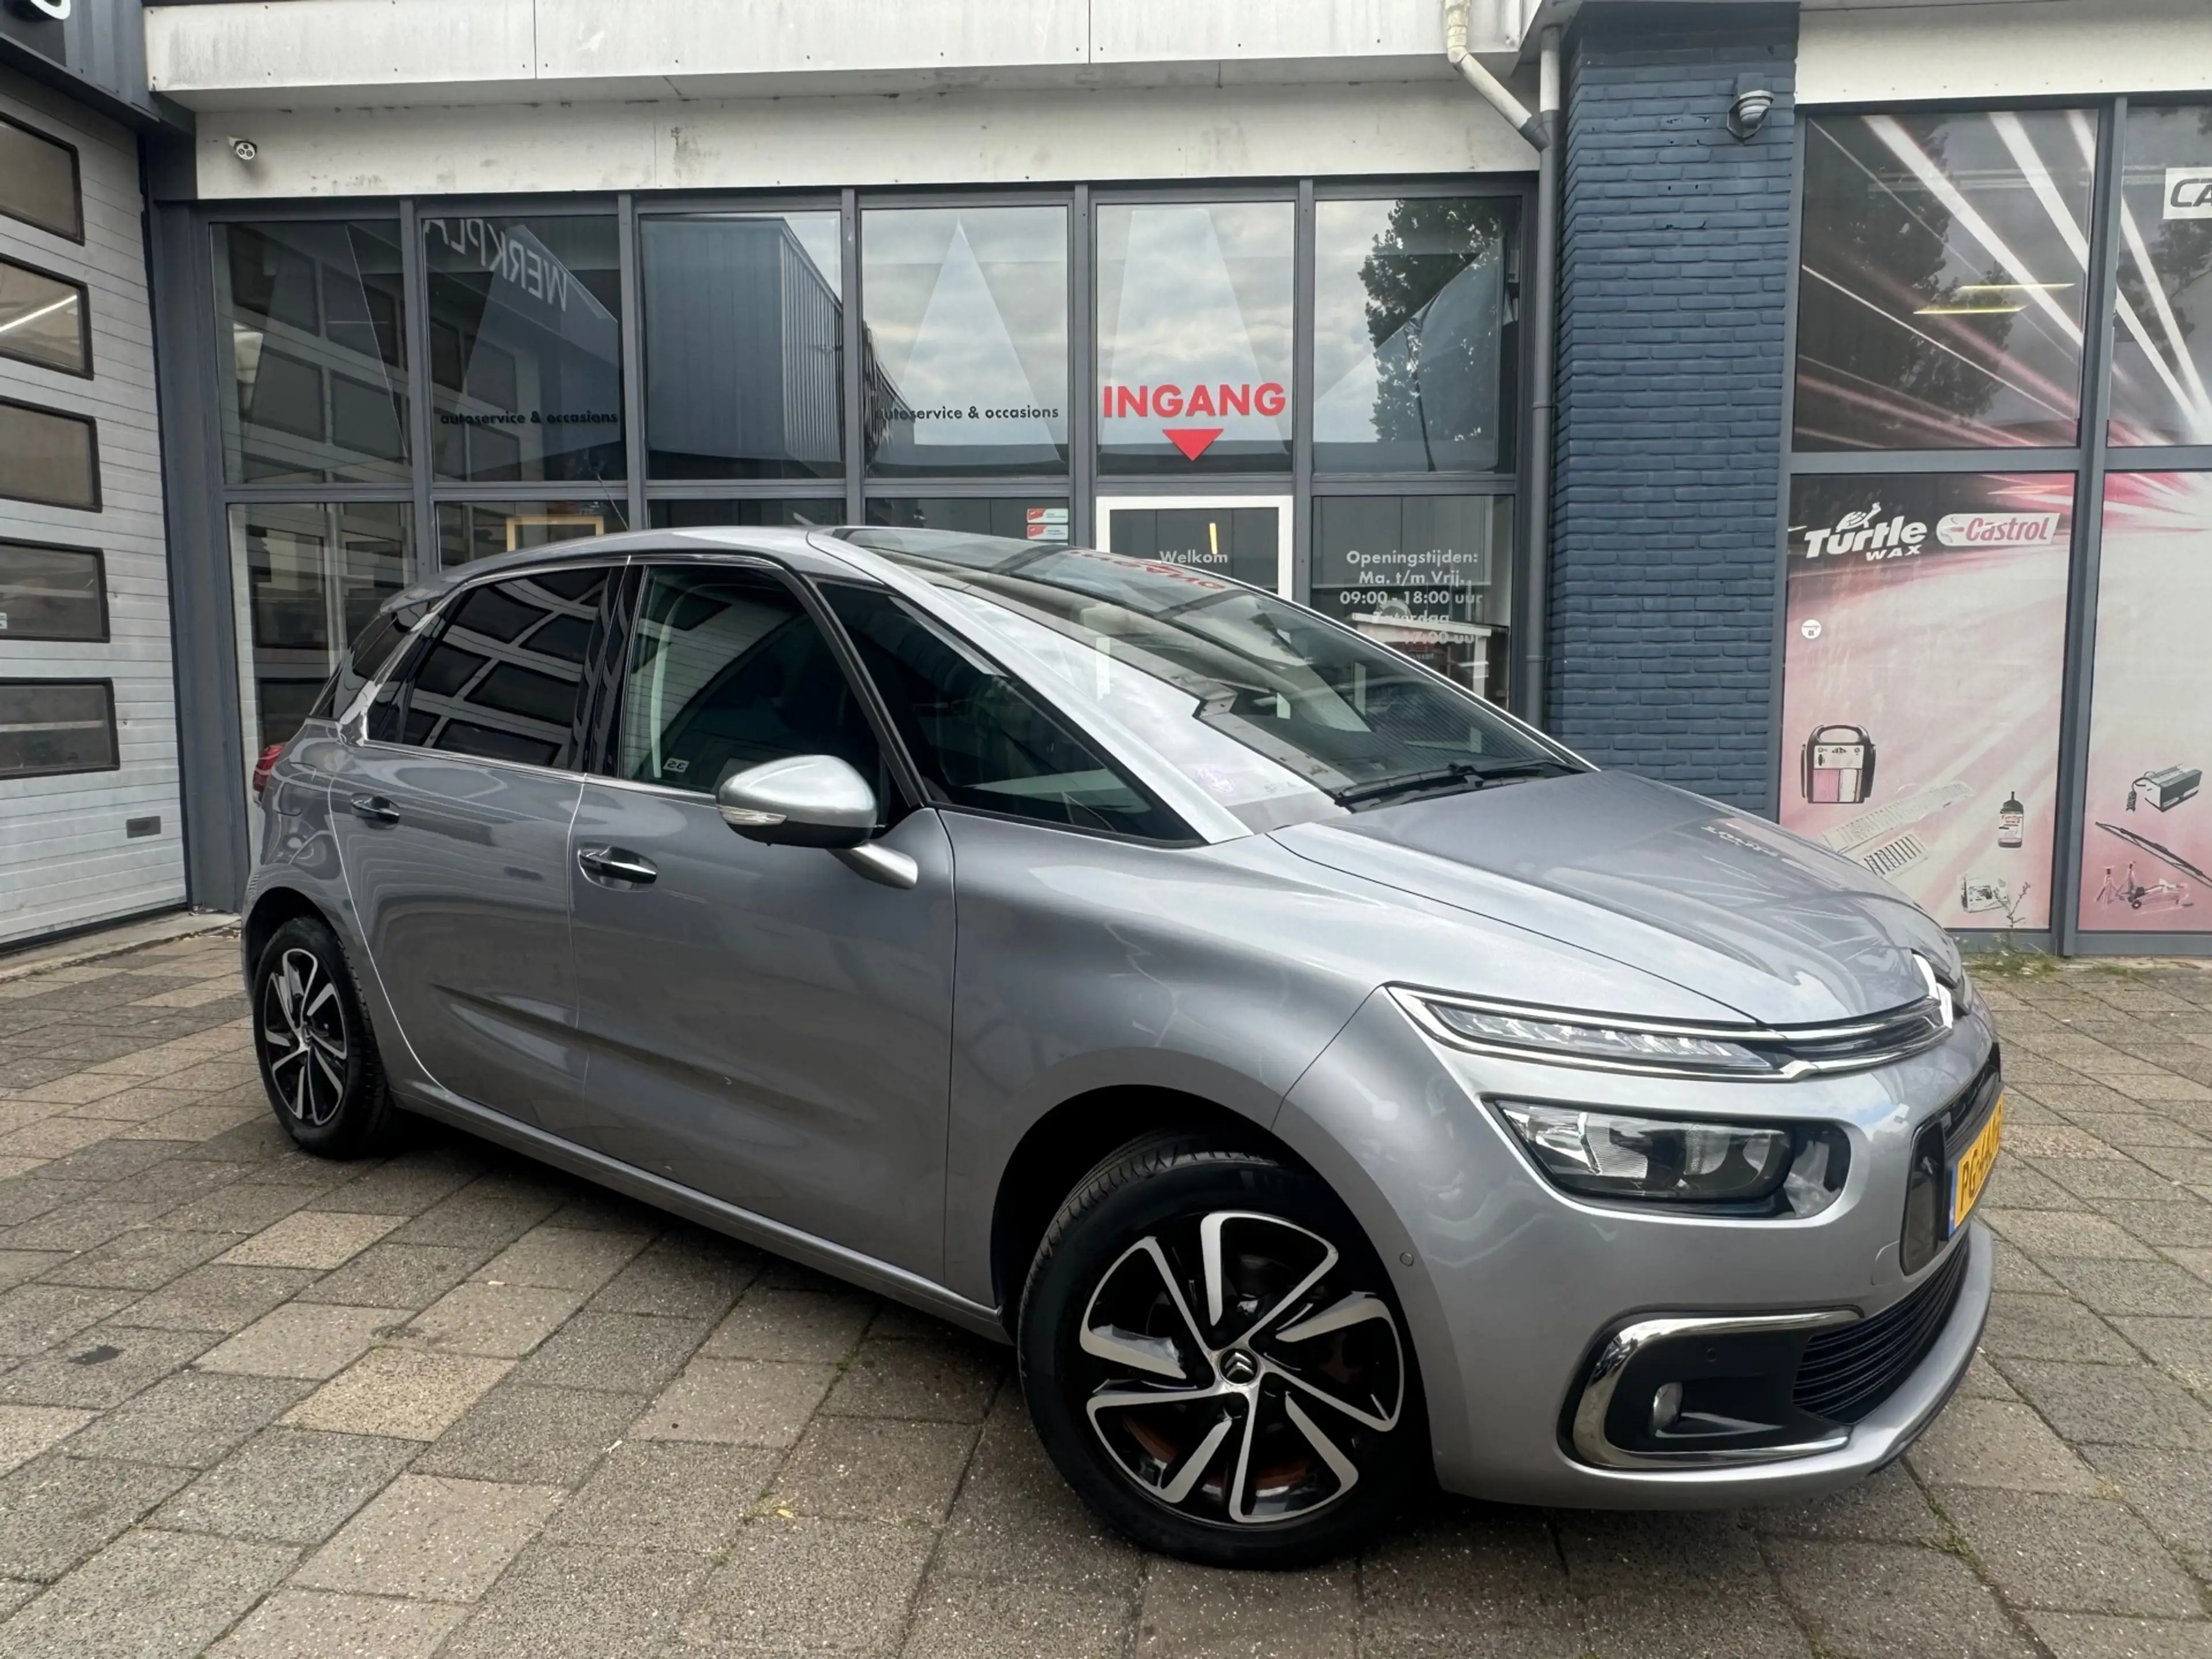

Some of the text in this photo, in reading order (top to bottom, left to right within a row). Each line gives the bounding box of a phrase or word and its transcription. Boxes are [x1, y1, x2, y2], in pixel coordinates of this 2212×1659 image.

[1103, 382, 1286, 418] INGANG
[440, 410, 618, 424] autoservice & occasions
[968, 406, 980, 419] &
[985, 405, 1059, 418] occasions
[1804, 516, 1927, 559] Turtle
[1965, 517, 2051, 541] Castrol
[1158, 549, 1228, 564] Welkom
[1346, 550, 1479, 567] Openingstijden:
[1865, 544, 1923, 561] WAX
[1358, 570, 1465, 588] Ma. t/m Vrij.
[1339, 591, 1388, 604] 09:00
[1404, 591, 1450, 604] 18:00
[1455, 594, 1483, 604] uur
